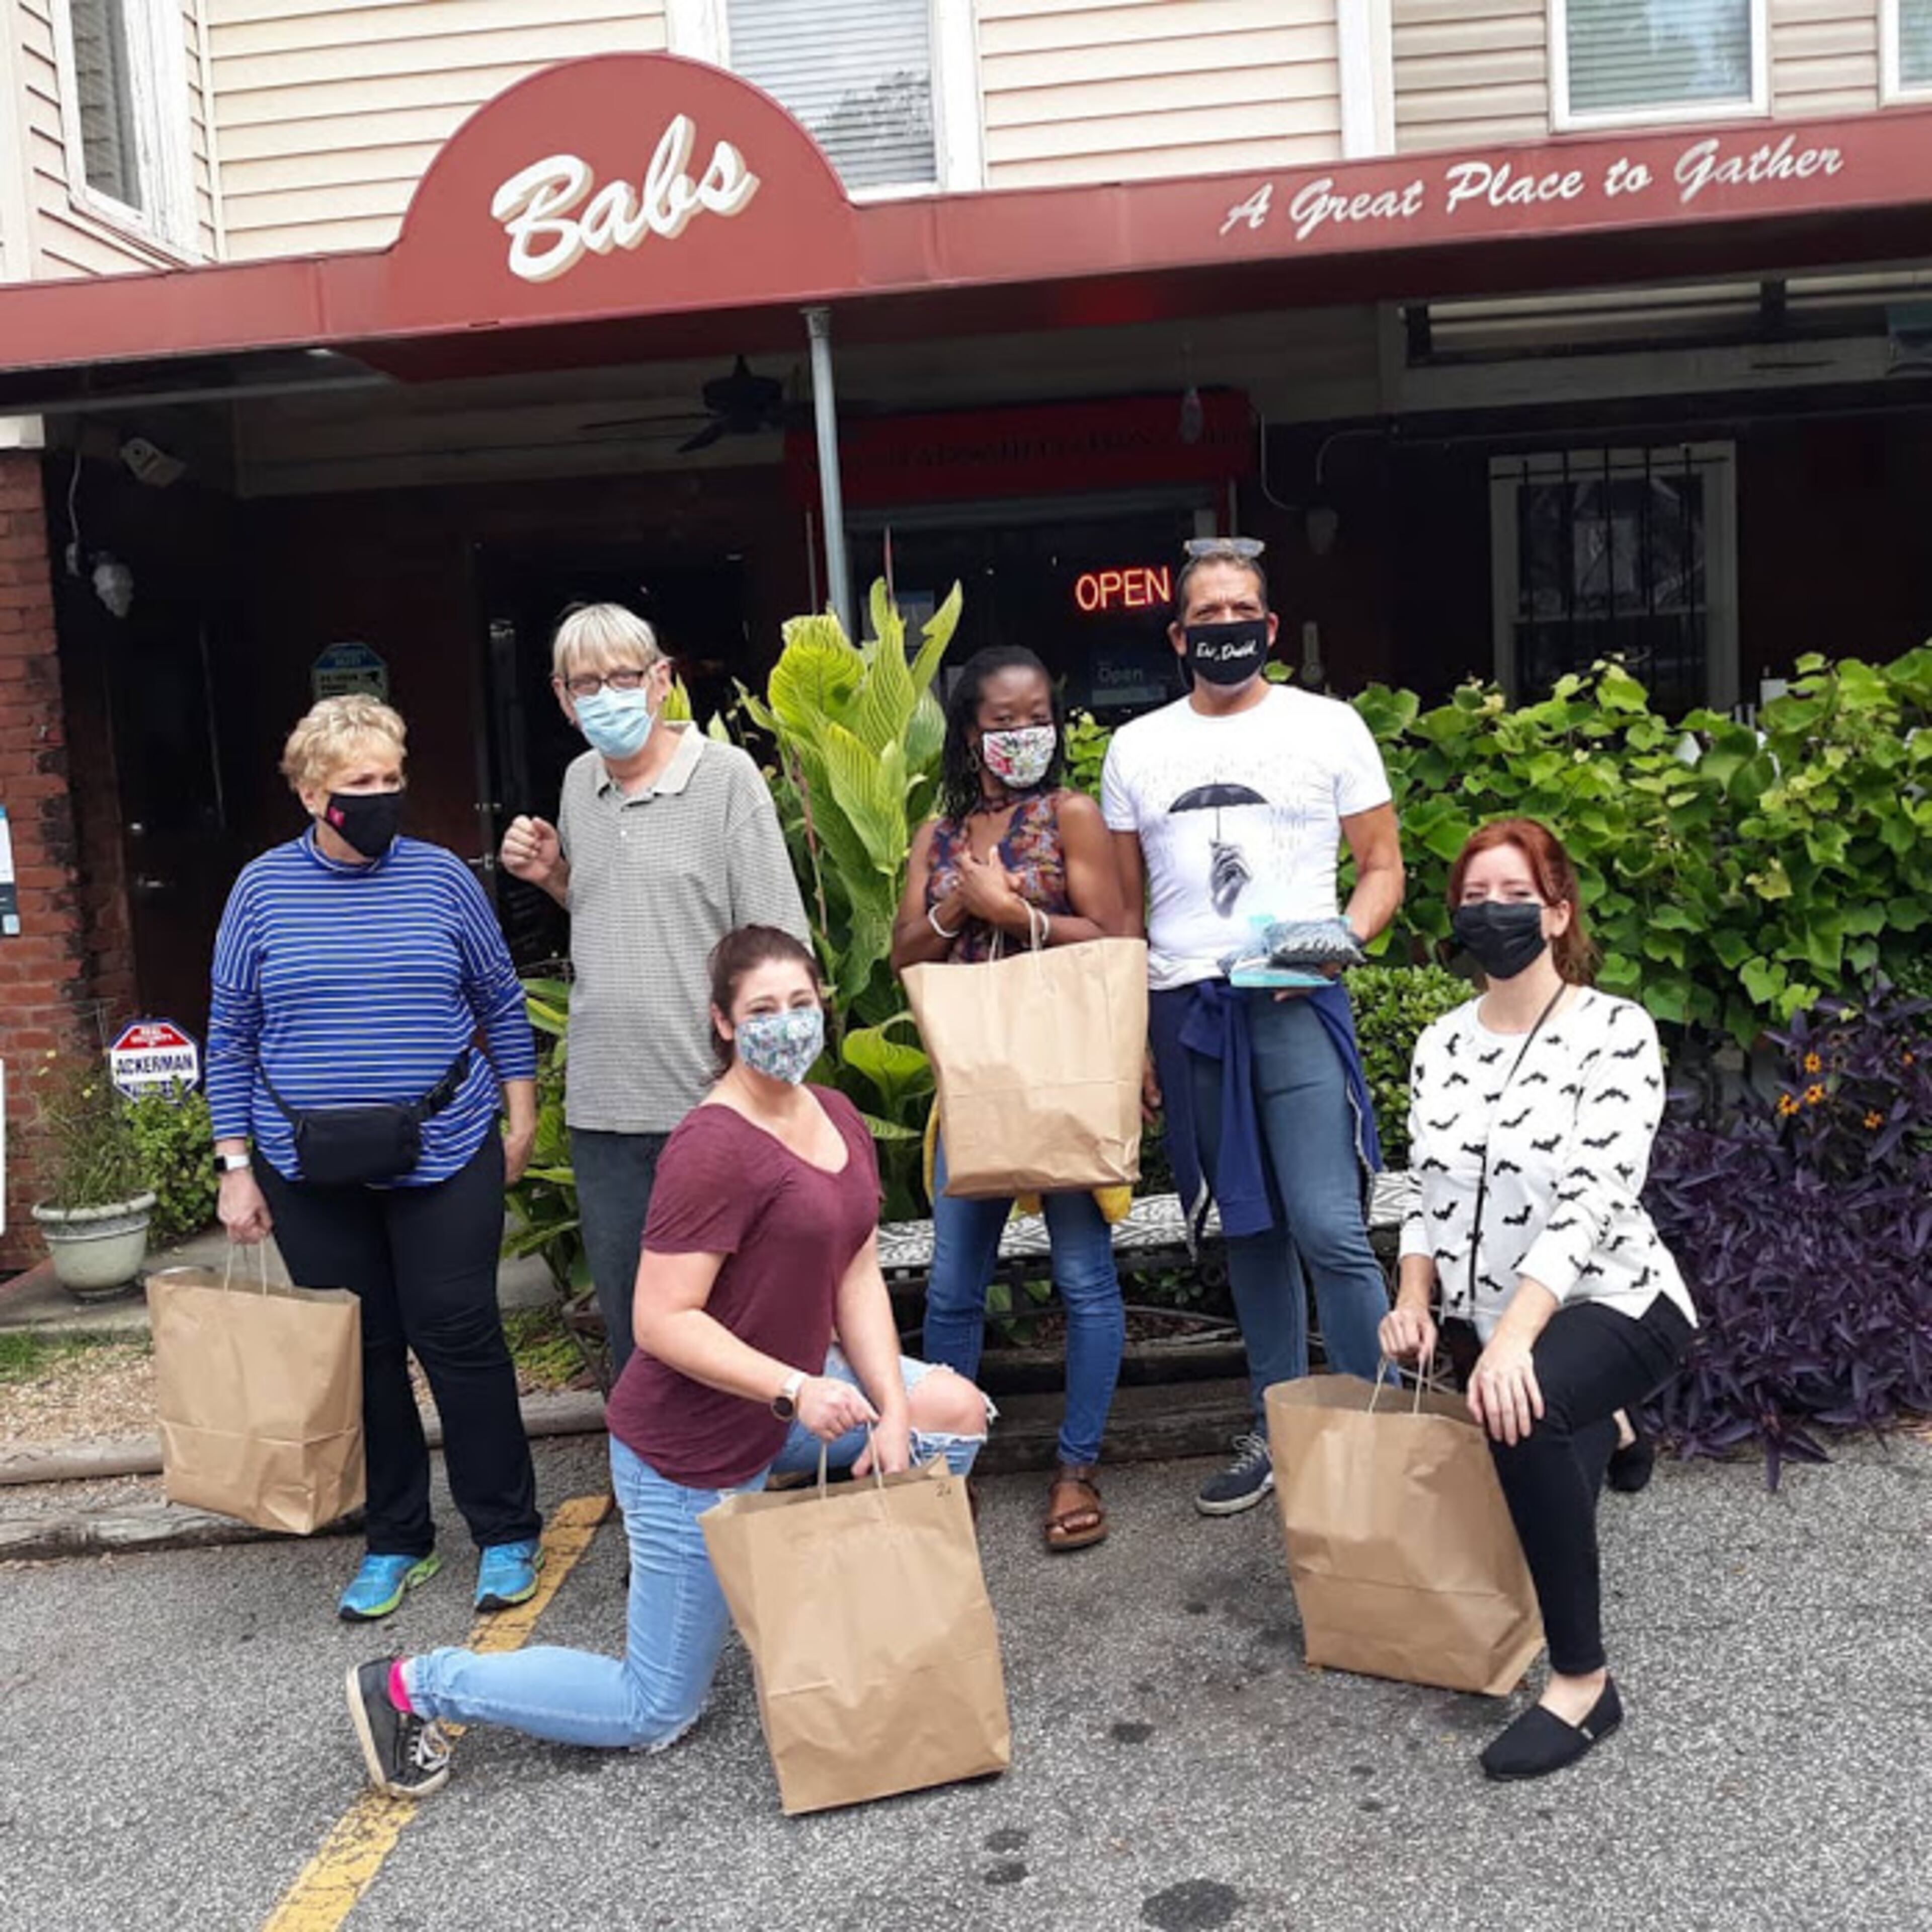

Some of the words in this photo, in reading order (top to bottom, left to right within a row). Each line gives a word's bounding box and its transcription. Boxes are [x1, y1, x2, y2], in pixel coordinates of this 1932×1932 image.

[491, 113, 760, 283] Babs
[1220, 182, 1273, 234] A
[1290, 178, 1424, 239] Great
[1446, 162, 1584, 212] Place
[1603, 157, 1652, 196] to
[1674, 134, 1844, 202] Gather
[1075, 567, 1170, 610] OPEN
[117, 1053, 193, 1075] ACKERMAN
